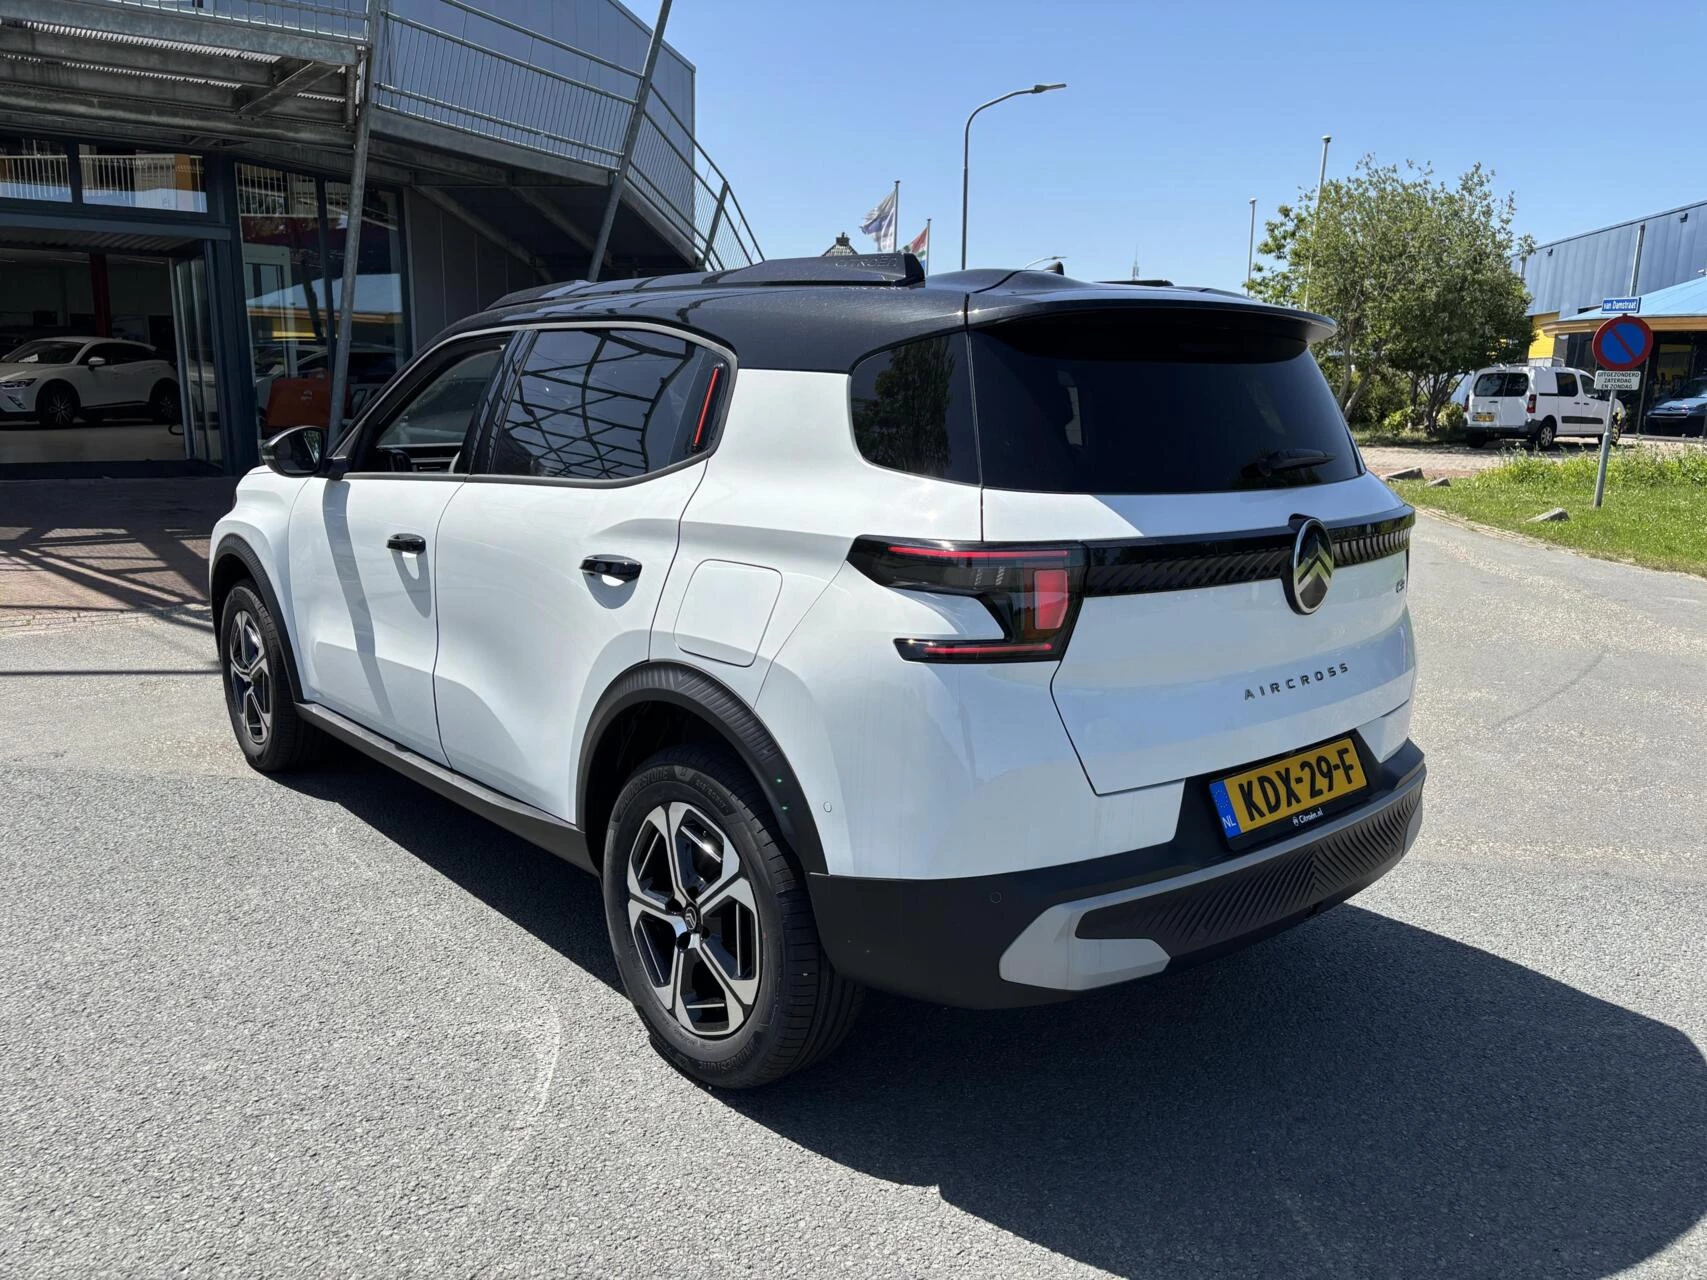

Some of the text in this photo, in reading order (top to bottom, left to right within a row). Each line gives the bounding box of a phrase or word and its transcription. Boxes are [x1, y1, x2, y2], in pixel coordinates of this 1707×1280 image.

[1612, 301, 1637, 309] Damstraat
[1244, 662, 1349, 701] AIRCROSS
[1238, 747, 1354, 822] KDX-29-F
[1222, 815, 1237, 829] NL
